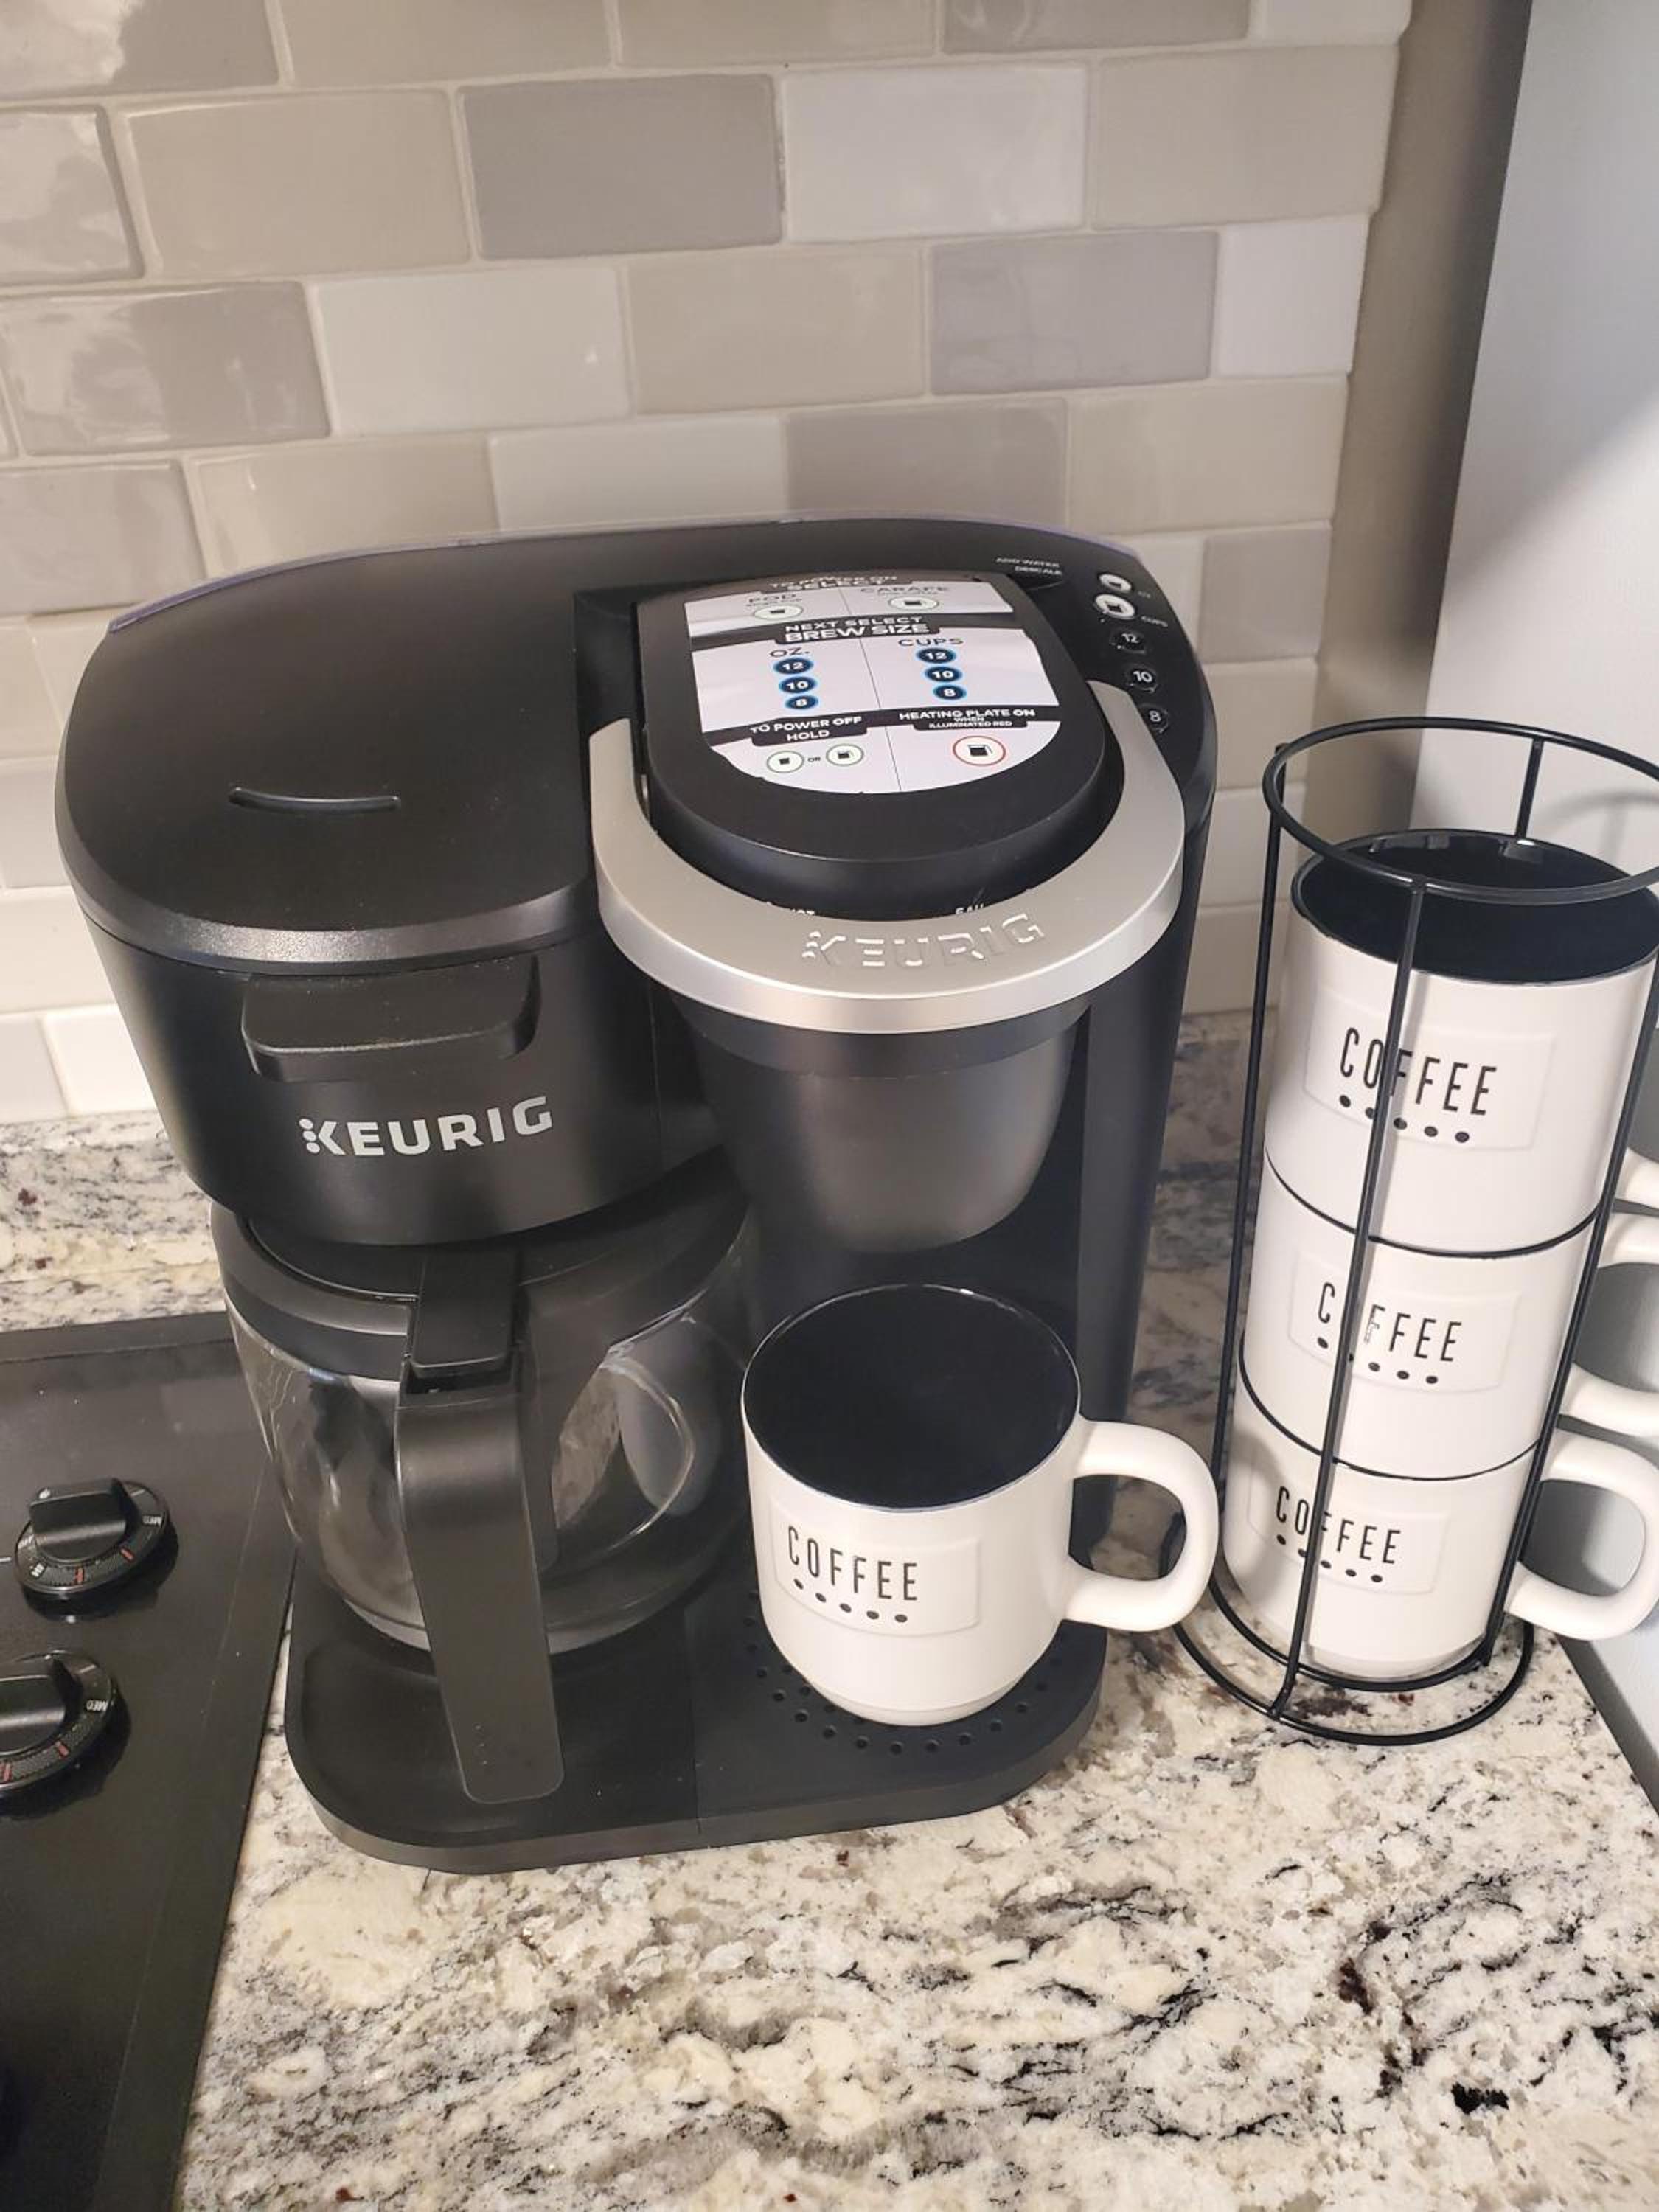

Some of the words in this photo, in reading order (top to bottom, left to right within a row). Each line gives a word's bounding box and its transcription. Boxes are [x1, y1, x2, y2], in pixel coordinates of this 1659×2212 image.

[785, 622, 837, 633] NEXT
[849, 616, 922, 627] SELECT
[785, 627, 866, 643] BREW
[872, 623, 930, 635] SIZE
[897, 638, 964, 648] CUPS
[769, 647, 810, 658] OZ.
[925, 652, 947, 660] 12
[782, 661, 804, 670] 12
[932, 669, 954, 680] 10
[1133, 669, 1153, 684] 10
[786, 681, 810, 690] 10
[943, 688, 956, 697] 8
[898, 709, 964, 721] HEATING
[965, 709, 1011, 718] PLATE
[1012, 709, 1037, 717] ON
[1149, 709, 1161, 723] 8
[750, 724, 771, 734] TO
[773, 719, 830, 732] POWER
[832, 716, 863, 726] OFF
[787, 729, 830, 742] HOLD
[802, 913, 1046, 968] KEURIG
[1340, 1027, 1498, 1116] COFFEE
[299, 1096, 553, 1156] KEURIG
[1318, 1281, 1462, 1362] CFFEE
[787, 1525, 918, 1601] COFFEE
